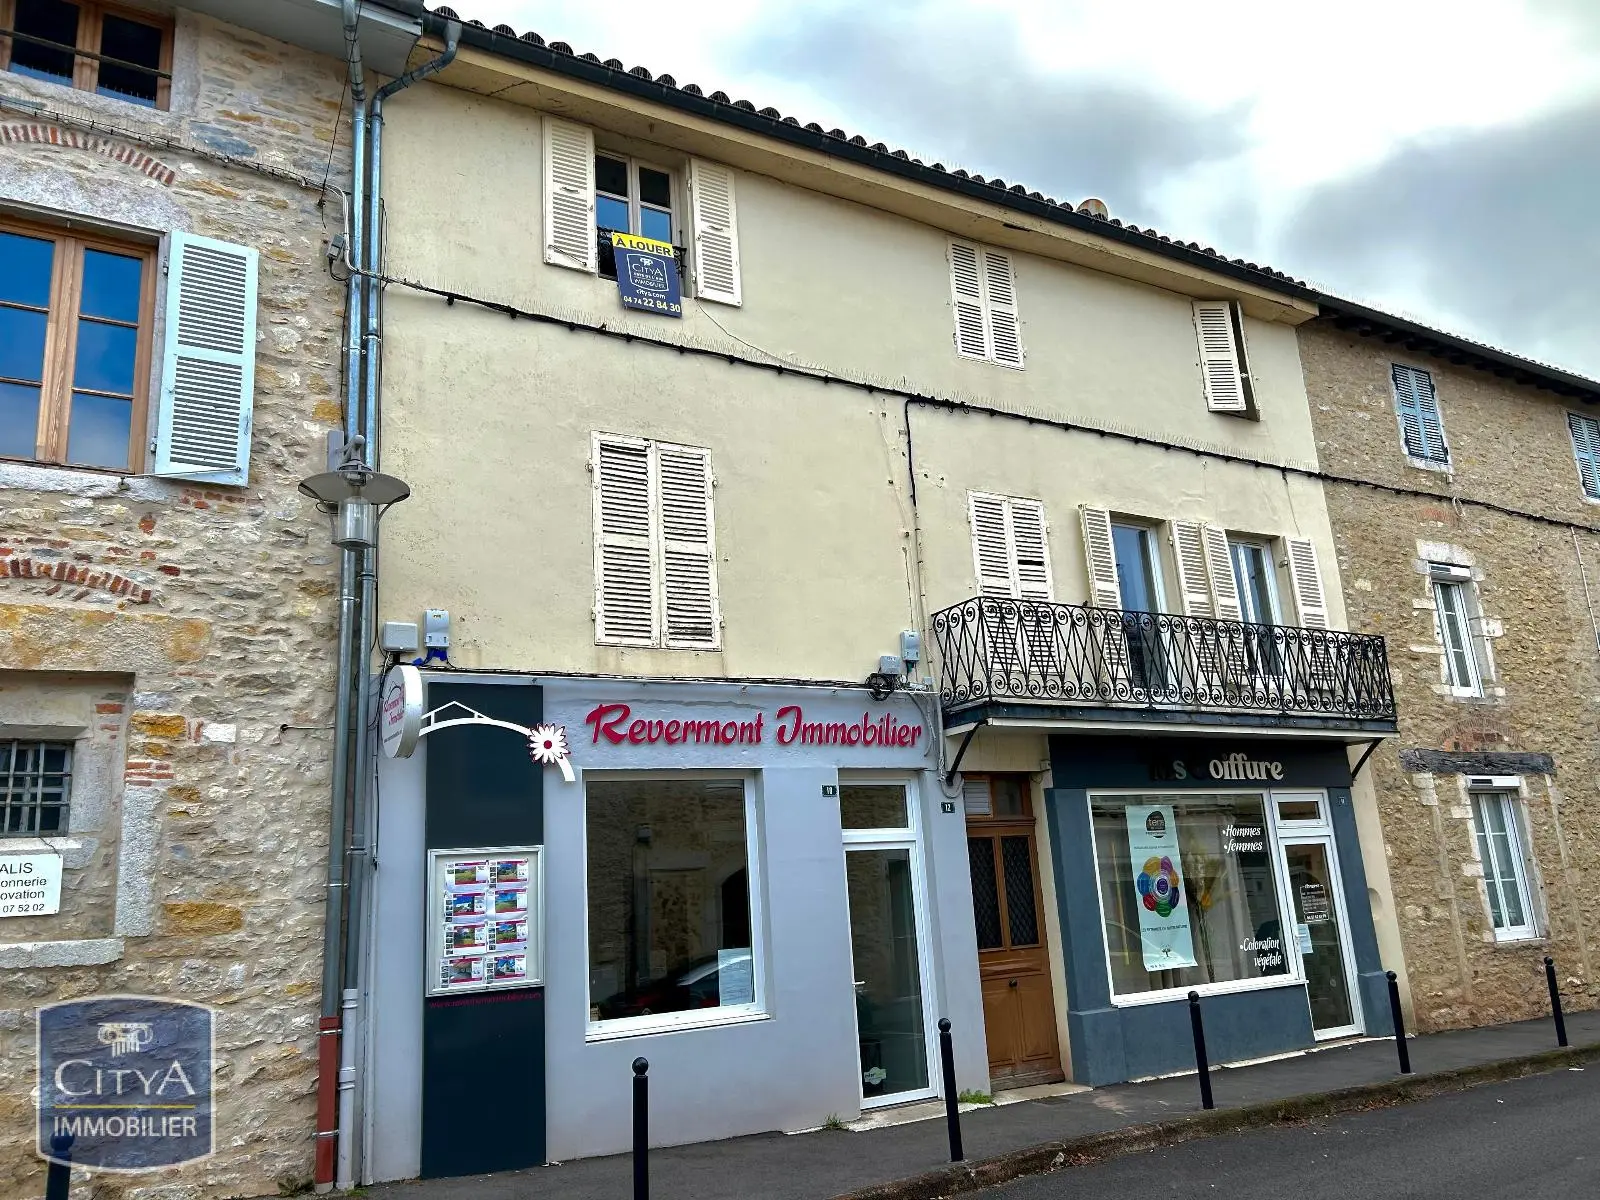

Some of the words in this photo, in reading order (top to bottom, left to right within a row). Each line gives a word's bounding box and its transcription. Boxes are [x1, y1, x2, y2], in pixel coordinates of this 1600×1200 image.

[629, 240, 671, 257] LOUER
[636, 289, 666, 300] citya.com
[623, 295, 632, 303] 04
[643, 298, 655, 308] 22
[656, 301, 668, 311] 84
[670, 303, 681, 313] 30
[585, 703, 763, 746] Revermont
[776, 705, 922, 747] Immobilier
[1208, 752, 1284, 780] oiffure
[1225, 824, 1262, 838] Hommes
[1226, 838, 1263, 854] femmes
[3, 904, 15, 913] 07
[18, 903, 30, 913] 52
[32, 903, 45, 912] 02
[1243, 936, 1280, 952] Coloration
[1254, 951, 1282, 972] végétale
